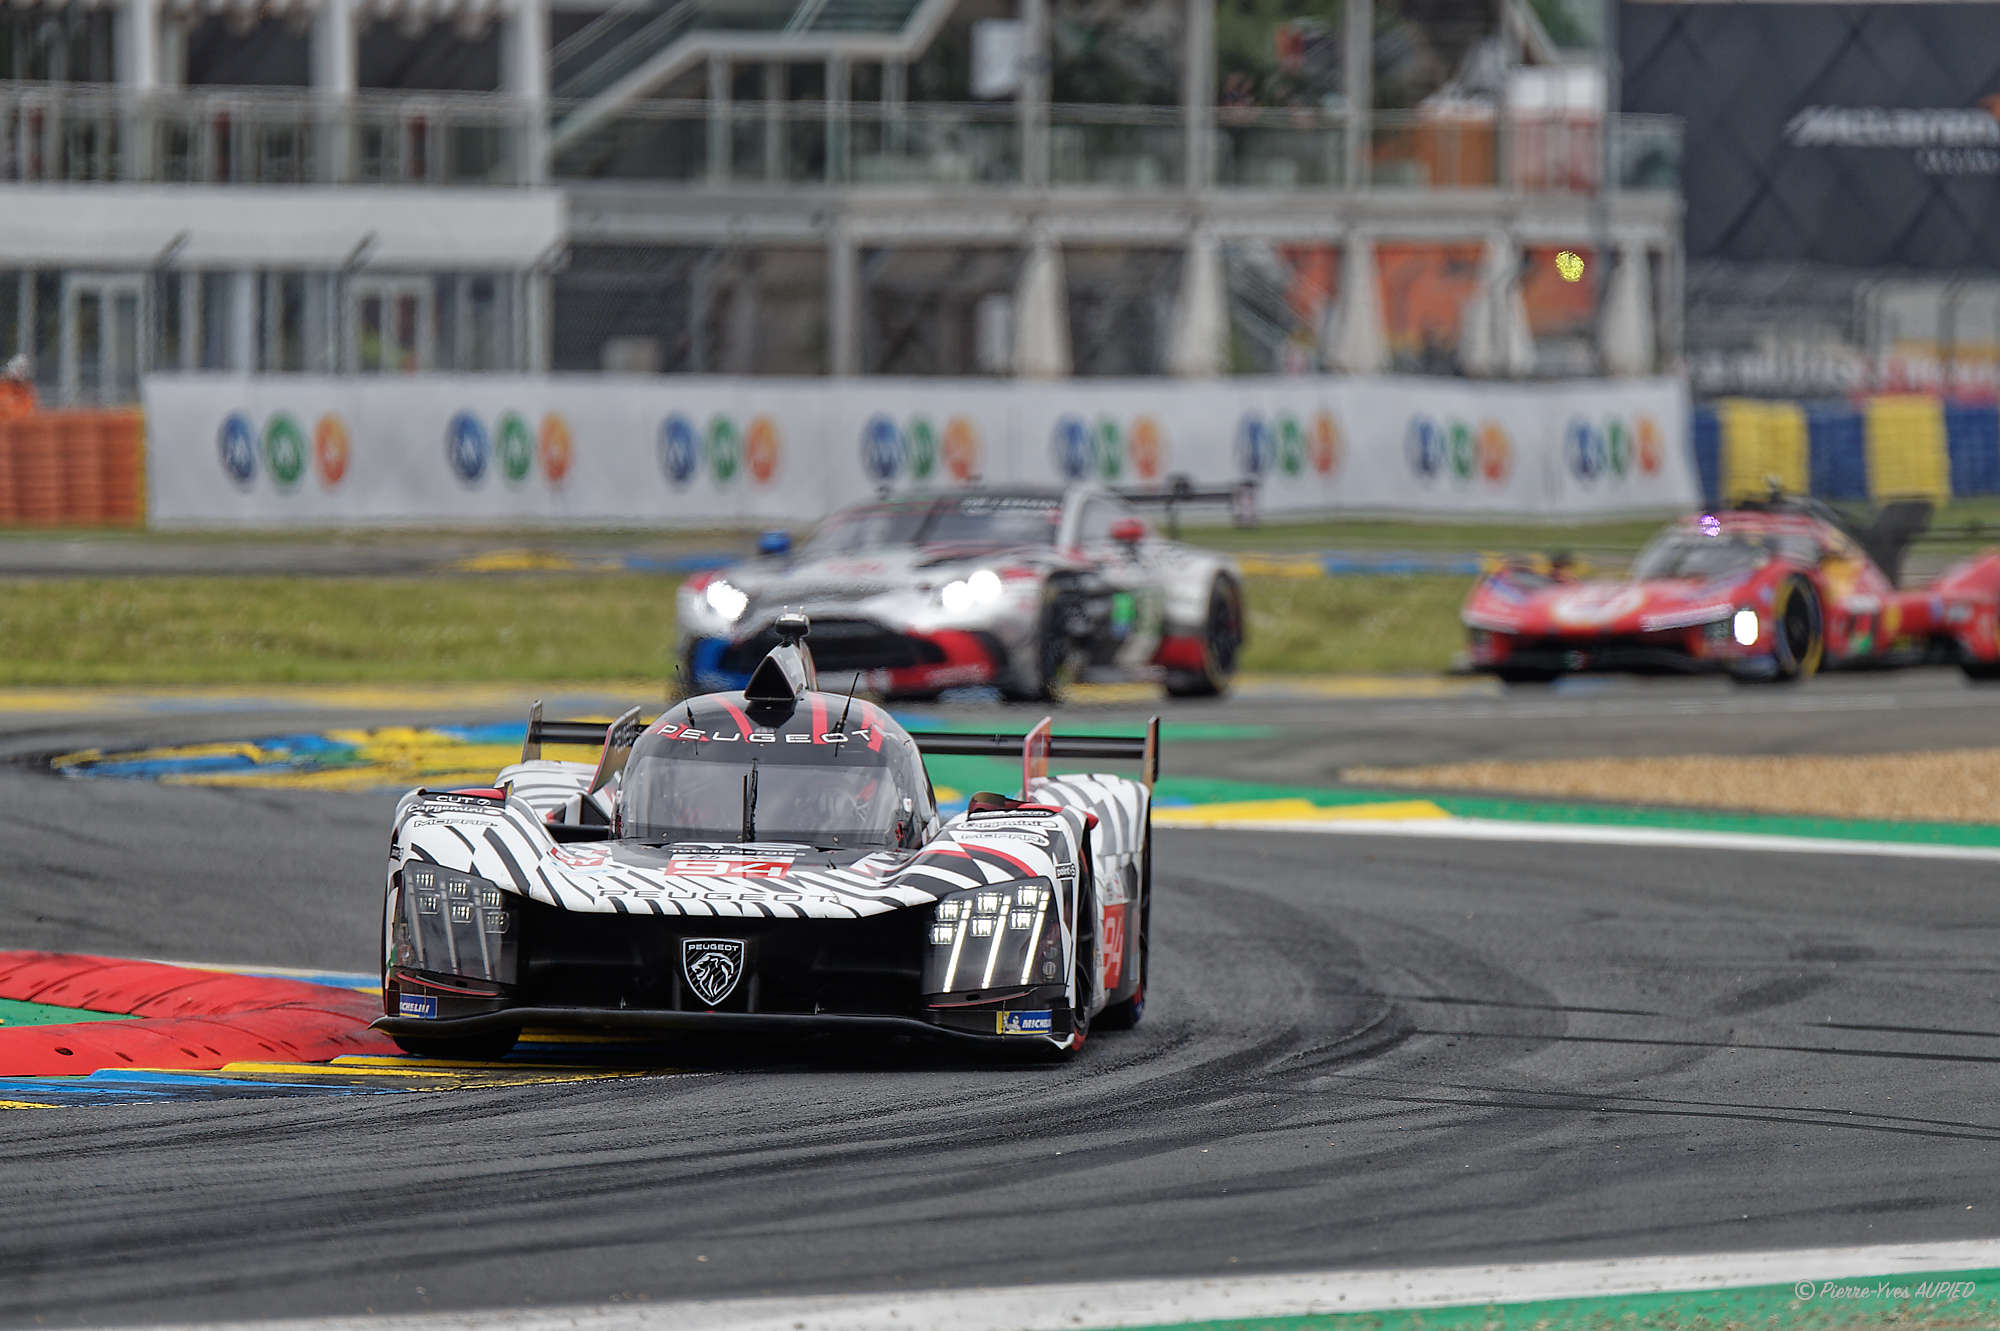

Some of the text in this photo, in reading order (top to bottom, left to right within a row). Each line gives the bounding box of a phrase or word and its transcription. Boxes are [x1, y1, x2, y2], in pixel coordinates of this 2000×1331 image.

[657, 724, 872, 744] PEUGEOT
[408, 804, 484, 814] Capgemini
[673, 860, 784, 878] 94
[599, 889, 838, 903] PEUGEOT
[688, 943, 739, 952] PEUGEOT
